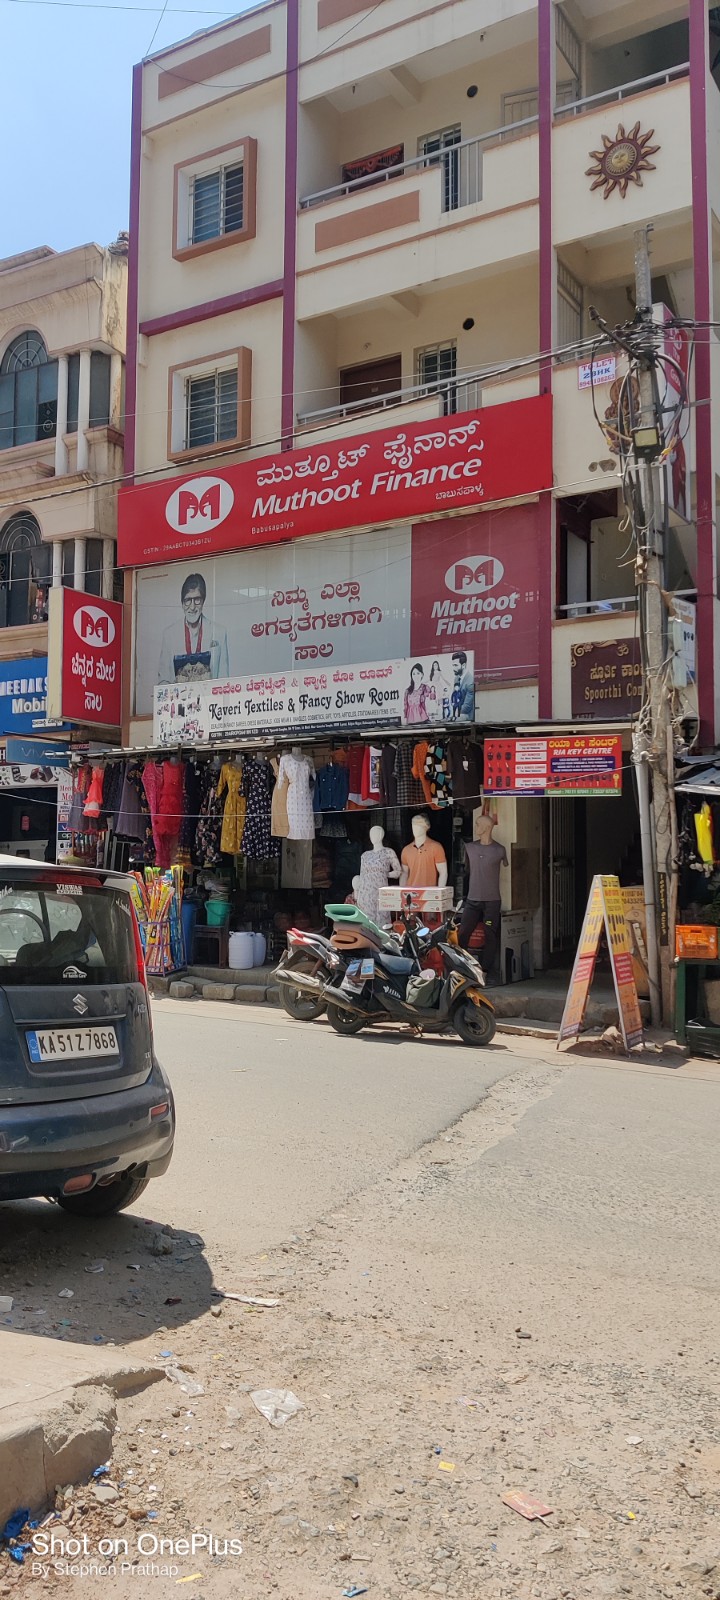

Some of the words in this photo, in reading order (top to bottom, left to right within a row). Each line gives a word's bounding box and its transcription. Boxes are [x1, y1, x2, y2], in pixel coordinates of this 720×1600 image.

[256, 443, 370, 486] ಮುತ್ತೂಟ್
[383, 420, 484, 469] ಫೈನಾನ್ಸ್
[251, 478, 363, 518] Muthoot
[370, 457, 482, 496] Finance
[251, 520, 294, 535] Babusapalya
[271, 585, 309, 611] ನಿಮ್ಮ
[320, 581, 361, 603] ಎಲ್ಲಾ
[431, 591, 518, 619] Muthoot
[435, 614, 513, 637] Finance
[294, 642, 334, 661] ಸಾಲ
[291, 678, 298, 688] &
[584, 683, 622, 703] Spoorthi
[84, 691, 103, 712] ಸಾಲ
[209, 701, 242, 721] Kaveri
[244, 697, 284, 716] Textiles
[287, 697, 296, 713] &
[298, 693, 332, 711] Fancy
[335, 691, 366, 709] Show
[368, 687, 400, 707] Room
[582, 747, 613, 755] CENTRE
[56, 883, 83, 891] VISWAS
[38, 1032, 116, 1055] KA51Z7868
